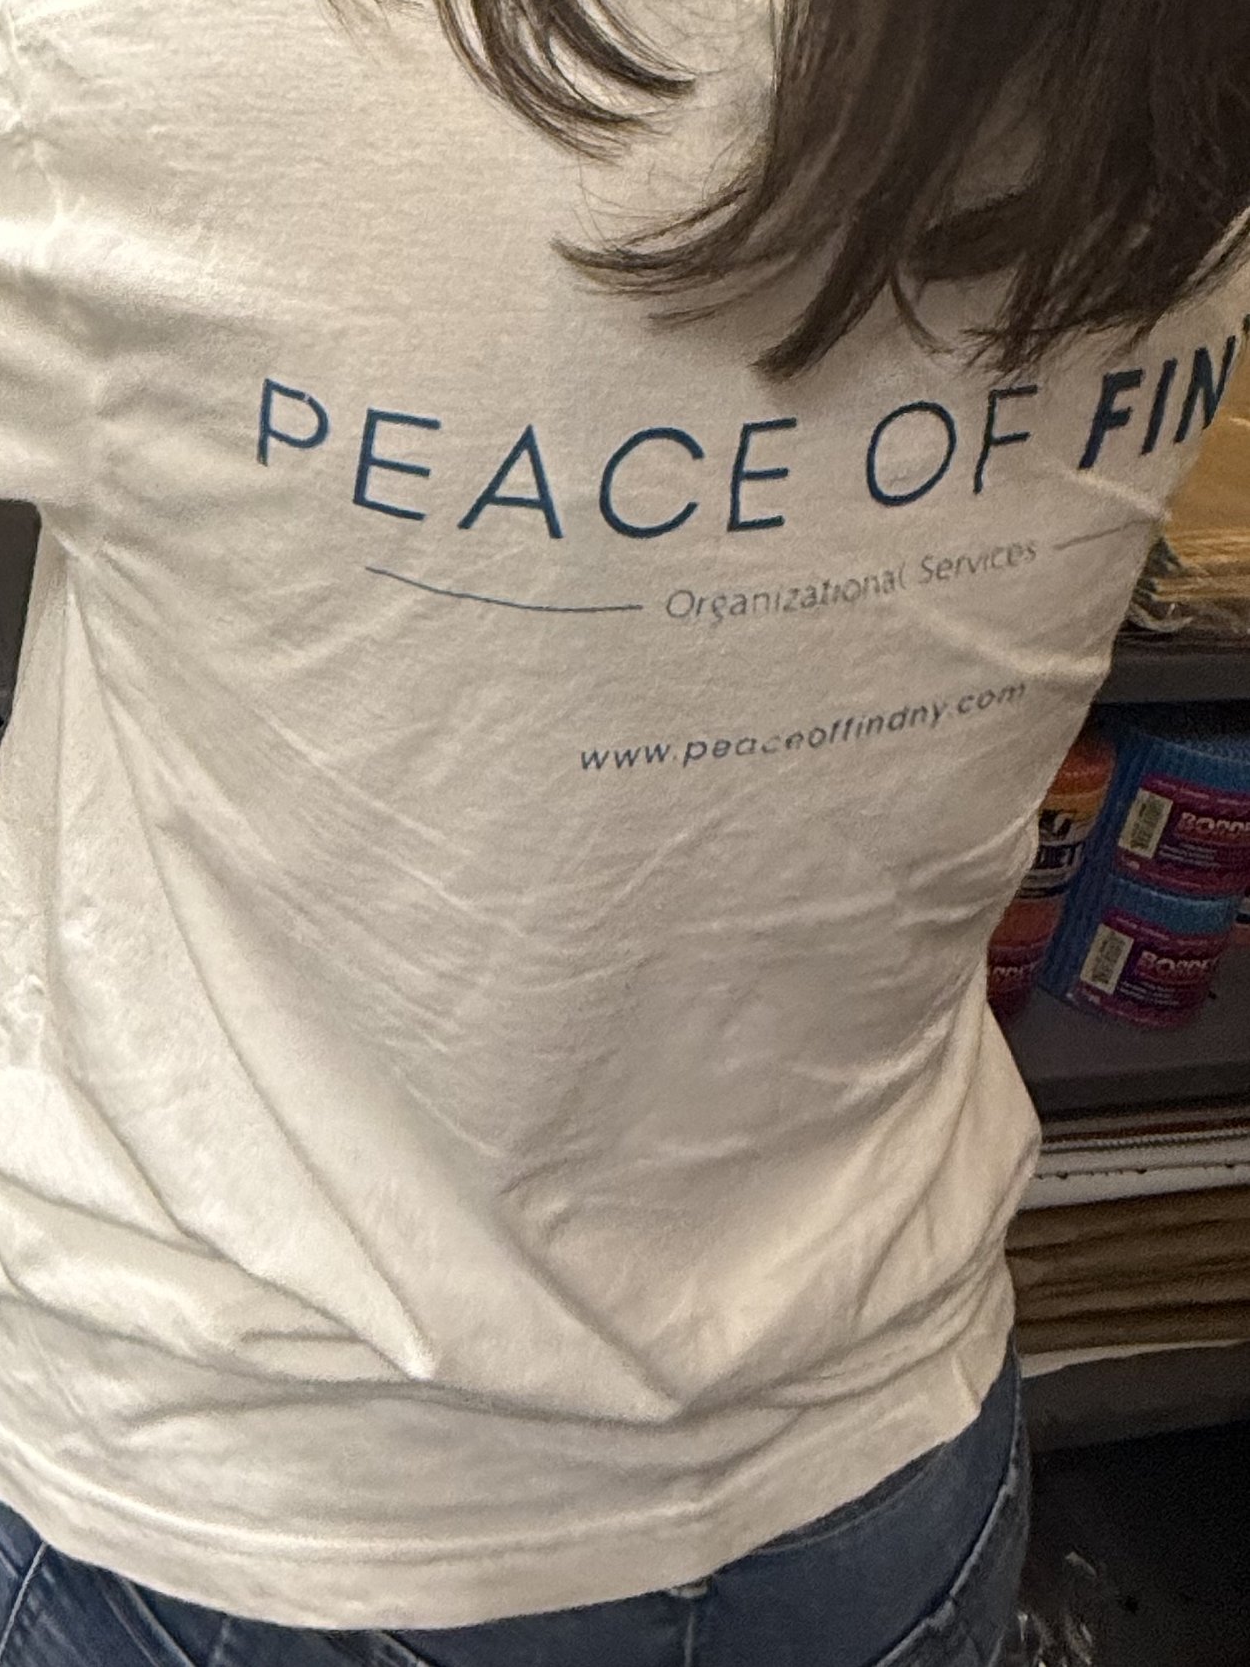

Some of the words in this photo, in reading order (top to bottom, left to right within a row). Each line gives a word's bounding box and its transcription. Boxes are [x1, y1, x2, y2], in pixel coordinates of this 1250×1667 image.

[256, 377, 798, 540] PEACE
[865, 384, 1039, 507] OF
[1078, 314, 1250, 470] FIN
[665, 563, 907, 626] Organizational
[920, 539, 1037, 585] Services
[580, 682, 1026, 771] www.peaceoffindny.com
